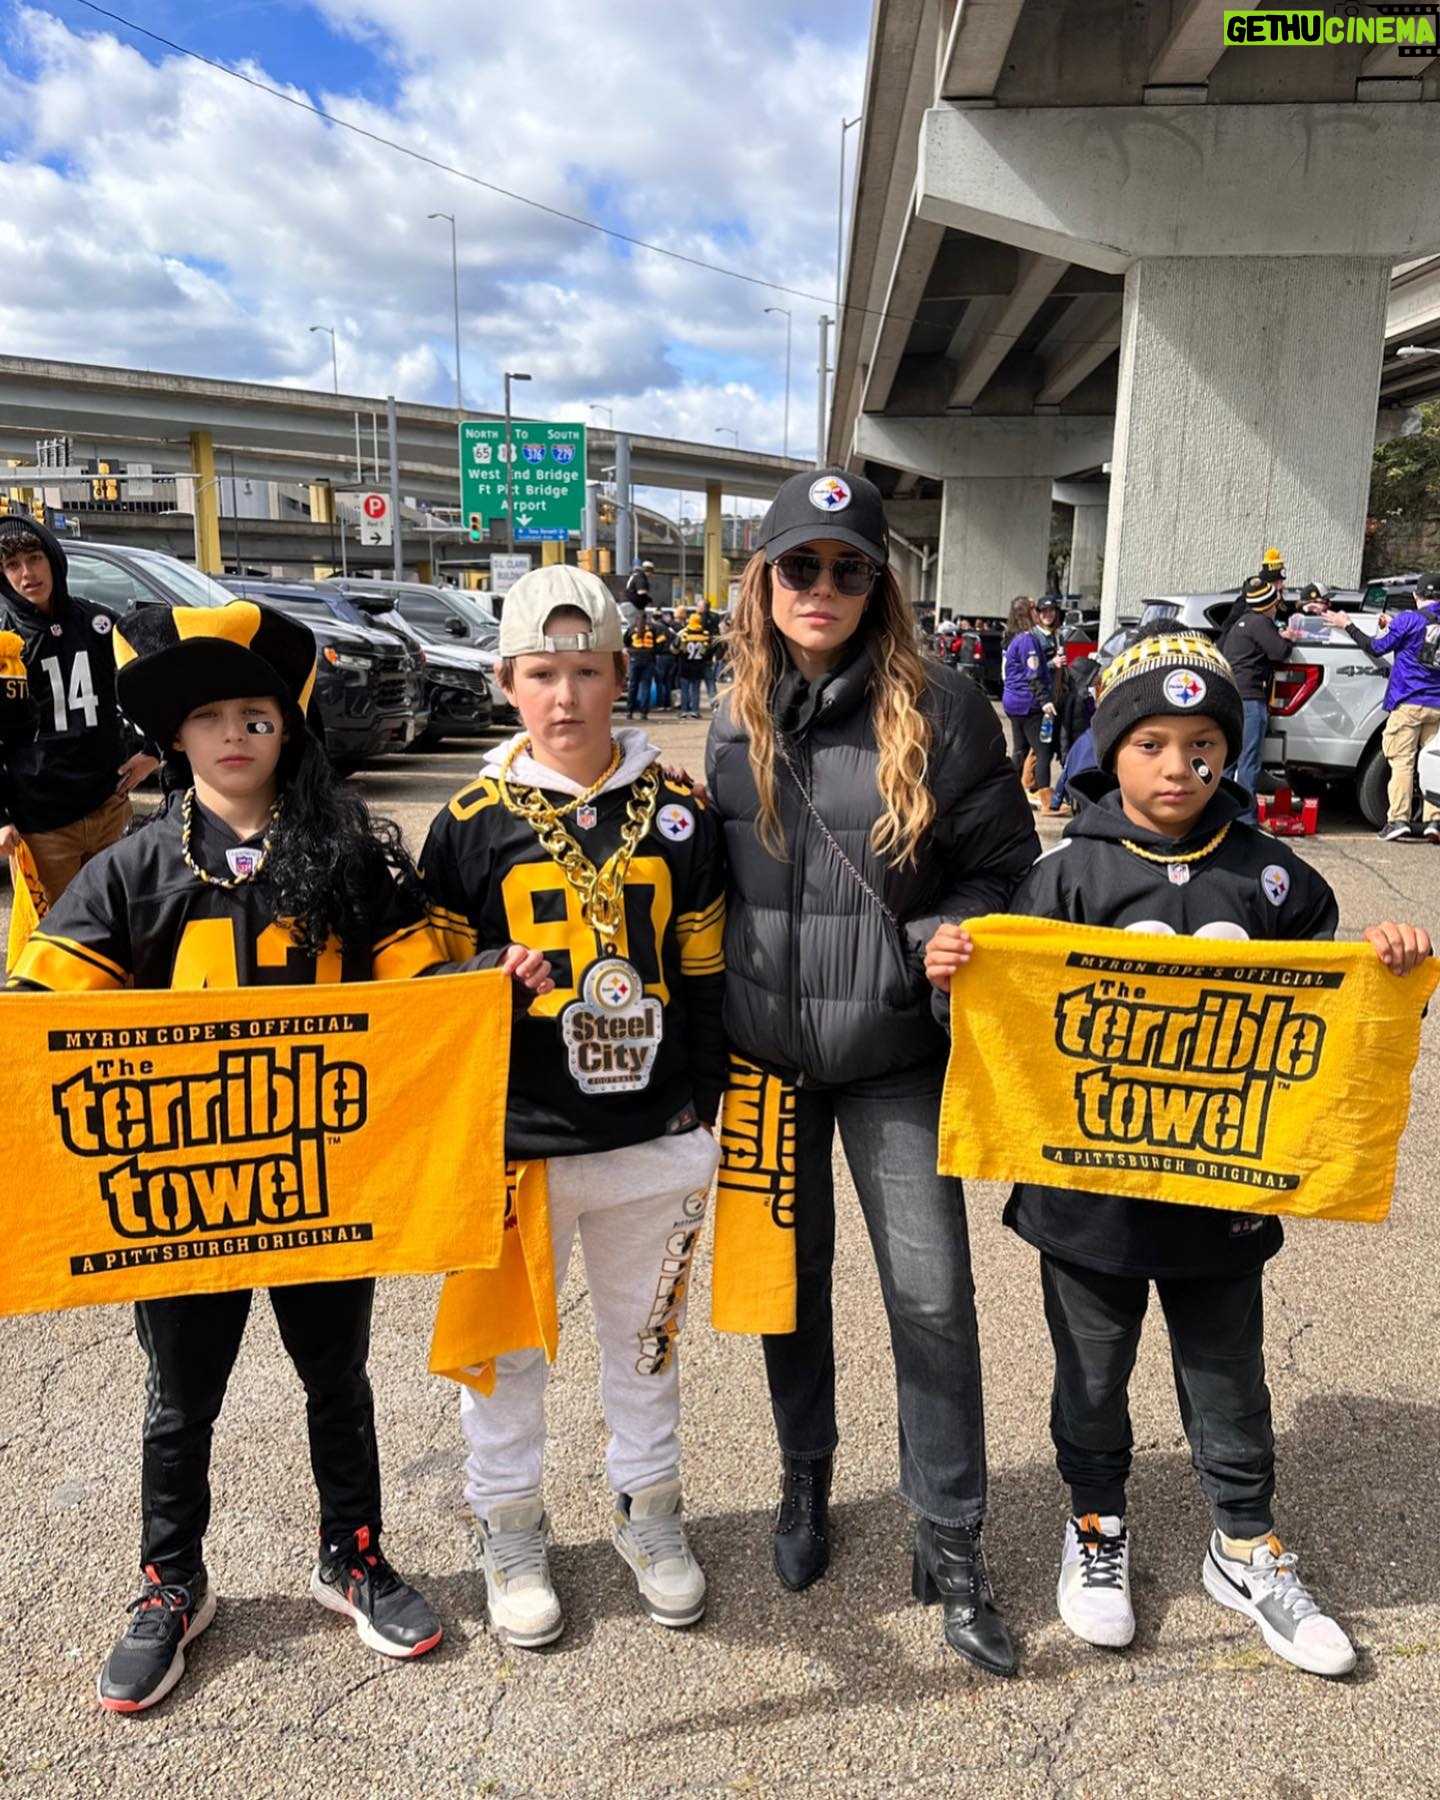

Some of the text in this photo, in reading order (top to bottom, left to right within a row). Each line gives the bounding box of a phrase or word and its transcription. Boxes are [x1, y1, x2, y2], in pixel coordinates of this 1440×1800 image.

[476, 447, 489, 459] 65
[527, 448, 543, 460] 376
[557, 448, 573, 460] 279
[468, 469, 501, 480] West
[536, 469, 579, 483] Bridge
[478, 484, 491, 495] Ft
[526, 484, 569, 498] Bridge
[500, 500, 546, 512] Arport
[686, 642, 703, 660] 92
[41, 650, 99, 731] 14
[1080, 956, 1325, 986] MYRON COPE'S OFFICIAL
[1101, 980, 1146, 999] The
[66, 1016, 354, 1049] MYRON COPE'S OFFICIAL
[572, 1008, 654, 1041] Steel
[1055, 982, 1326, 1081] terrible
[97, 1059, 153, 1077] The
[578, 1042, 649, 1073] City
[52, 1045, 368, 1157] terrible
[1075, 1065, 1274, 1160] towel
[99, 1132, 329, 1239] towel
[1054, 1151, 1287, 1189] A PITTSBURGH ORIGINAL
[83, 1228, 362, 1272] A PITTSBURGH ORIGINAL
